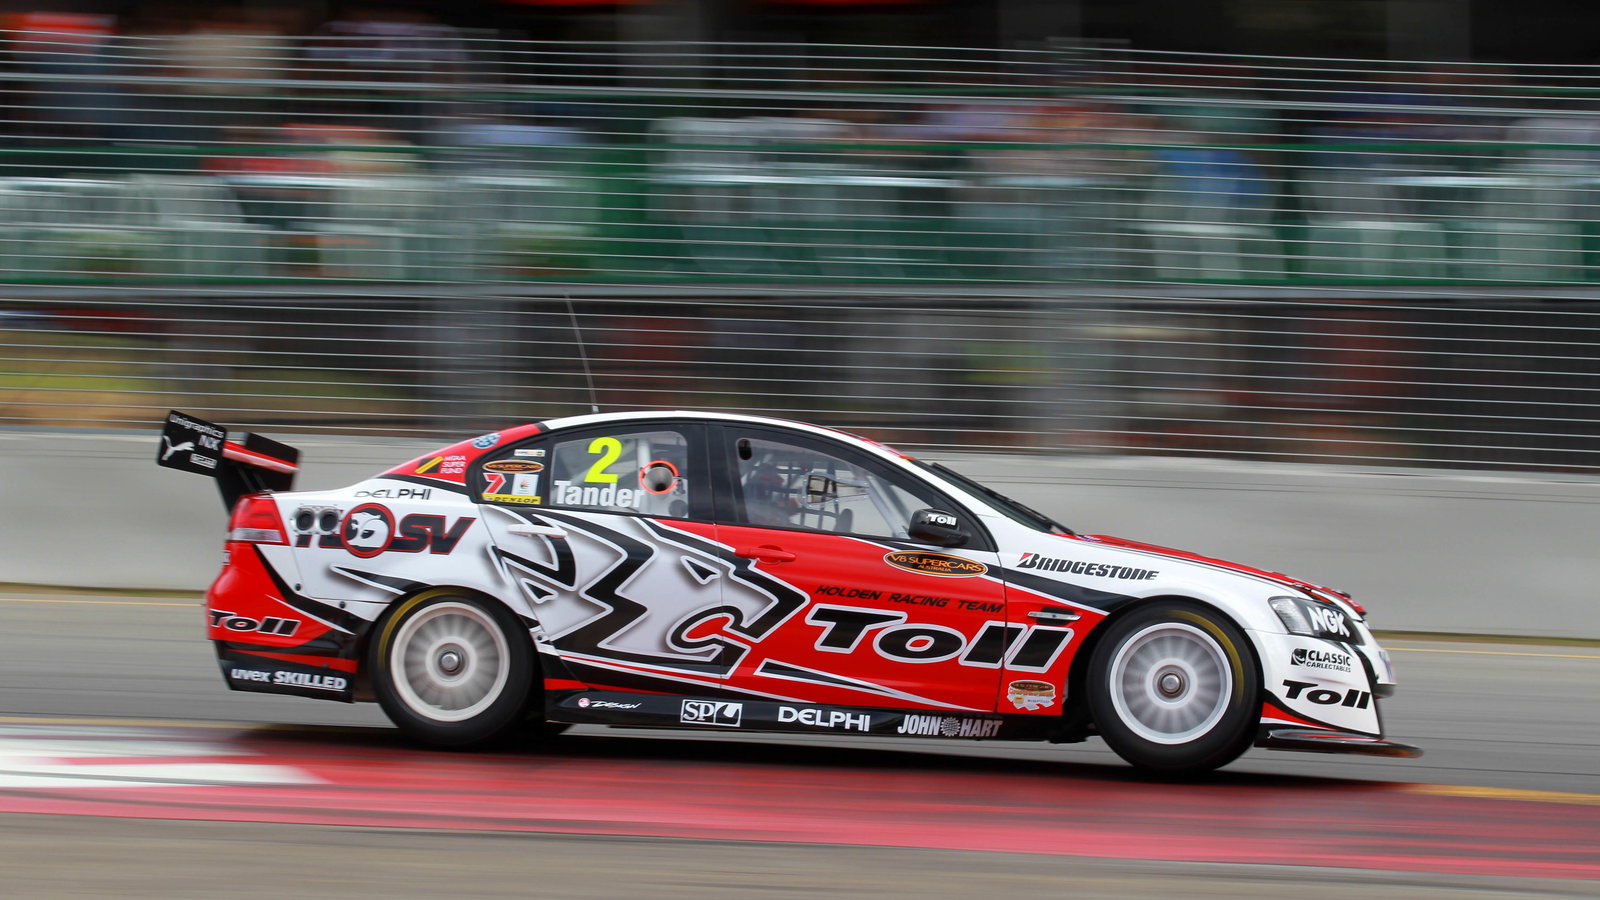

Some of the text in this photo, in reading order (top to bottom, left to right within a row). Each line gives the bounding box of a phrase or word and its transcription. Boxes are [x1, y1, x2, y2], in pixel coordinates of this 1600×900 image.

[198, 434, 221, 451] NX
[584, 436, 622, 483] 2
[354, 488, 432, 500] DELPHI
[494, 496, 539, 505] DUNLOP
[554, 480, 645, 508] Tander
[927, 513, 957, 526] Toll
[889, 553, 984, 573] V8 SUPERCARS
[917, 564, 952, 573] AUSTRALIA
[1016, 552, 1160, 581] BRIDGESTONE
[815, 585, 1005, 614] HOLDEN RACING TEAM
[208, 608, 302, 637] Toll
[1306, 605, 1350, 638] NGK
[805, 604, 1075, 673] Toll
[1306, 661, 1352, 673] CARLECTABLES
[1308, 649, 1351, 667] CLASSIC
[231, 668, 348, 692] uvex SKILLED
[1282, 679, 1372, 710] Toll
[682, 701, 715, 721] SP
[777, 706, 871, 732] DELPHI
[897, 714, 1004, 737] JOHN HART
